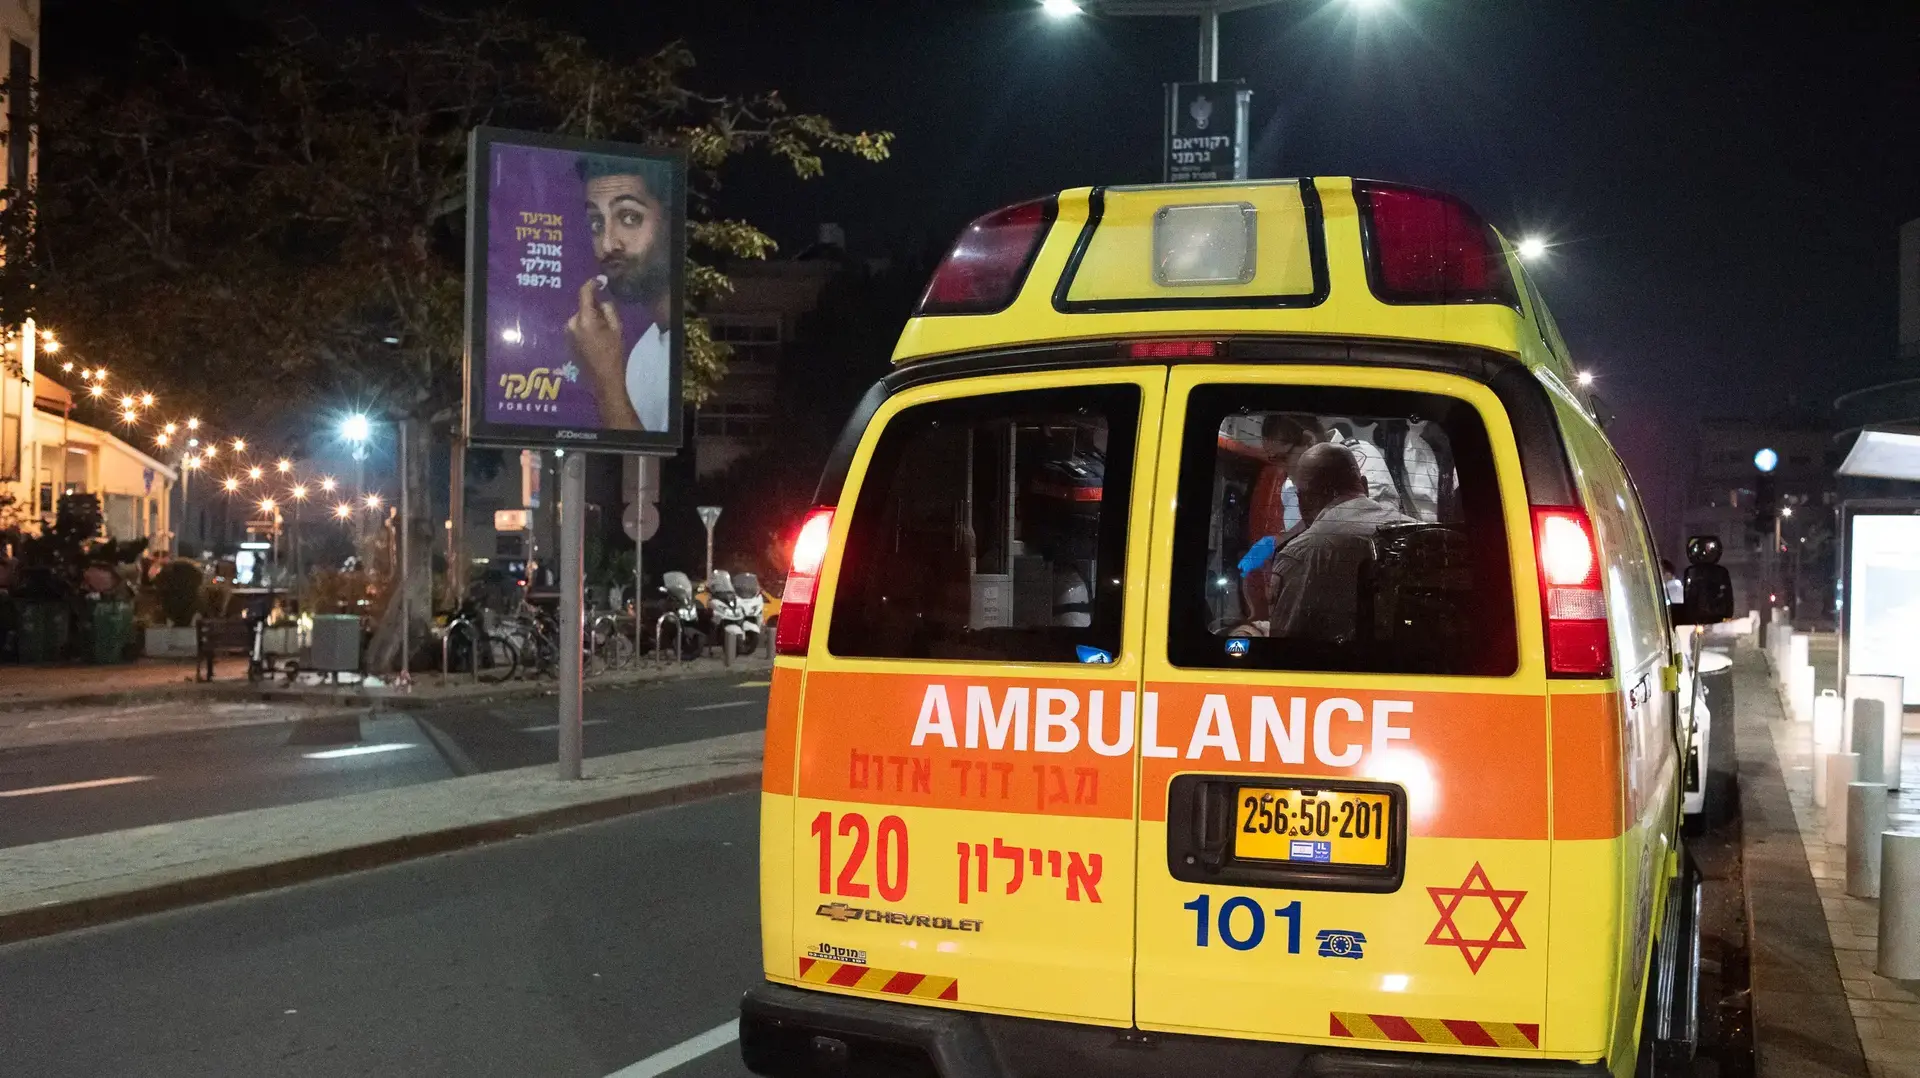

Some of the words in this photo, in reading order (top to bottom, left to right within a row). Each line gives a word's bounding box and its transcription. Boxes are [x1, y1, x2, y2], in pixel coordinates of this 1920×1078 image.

[1172, 136, 1230, 150] רקוויאם
[1172, 151, 1211, 164] גרמני
[520, 211, 563, 226] אביעד
[515, 226, 541, 241] ציון
[544, 229, 562, 241] הר
[527, 242, 562, 257] אוהב
[520, 256, 562, 272] מילקי
[499, 367, 562, 401] מילקי
[498, 402, 558, 413] FOREVER
[910, 683, 1415, 770] AMBULANCE
[849, 752, 931, 795] אדום
[951, 759, 1014, 800] דוד
[1033, 764, 1099, 811] מגן
[1317, 842, 1327, 850] IL
[811, 811, 909, 903] 120
[957, 837, 1103, 904] איילון
[864, 909, 984, 932] CHEVROLET
[1183, 894, 1302, 955] 101
